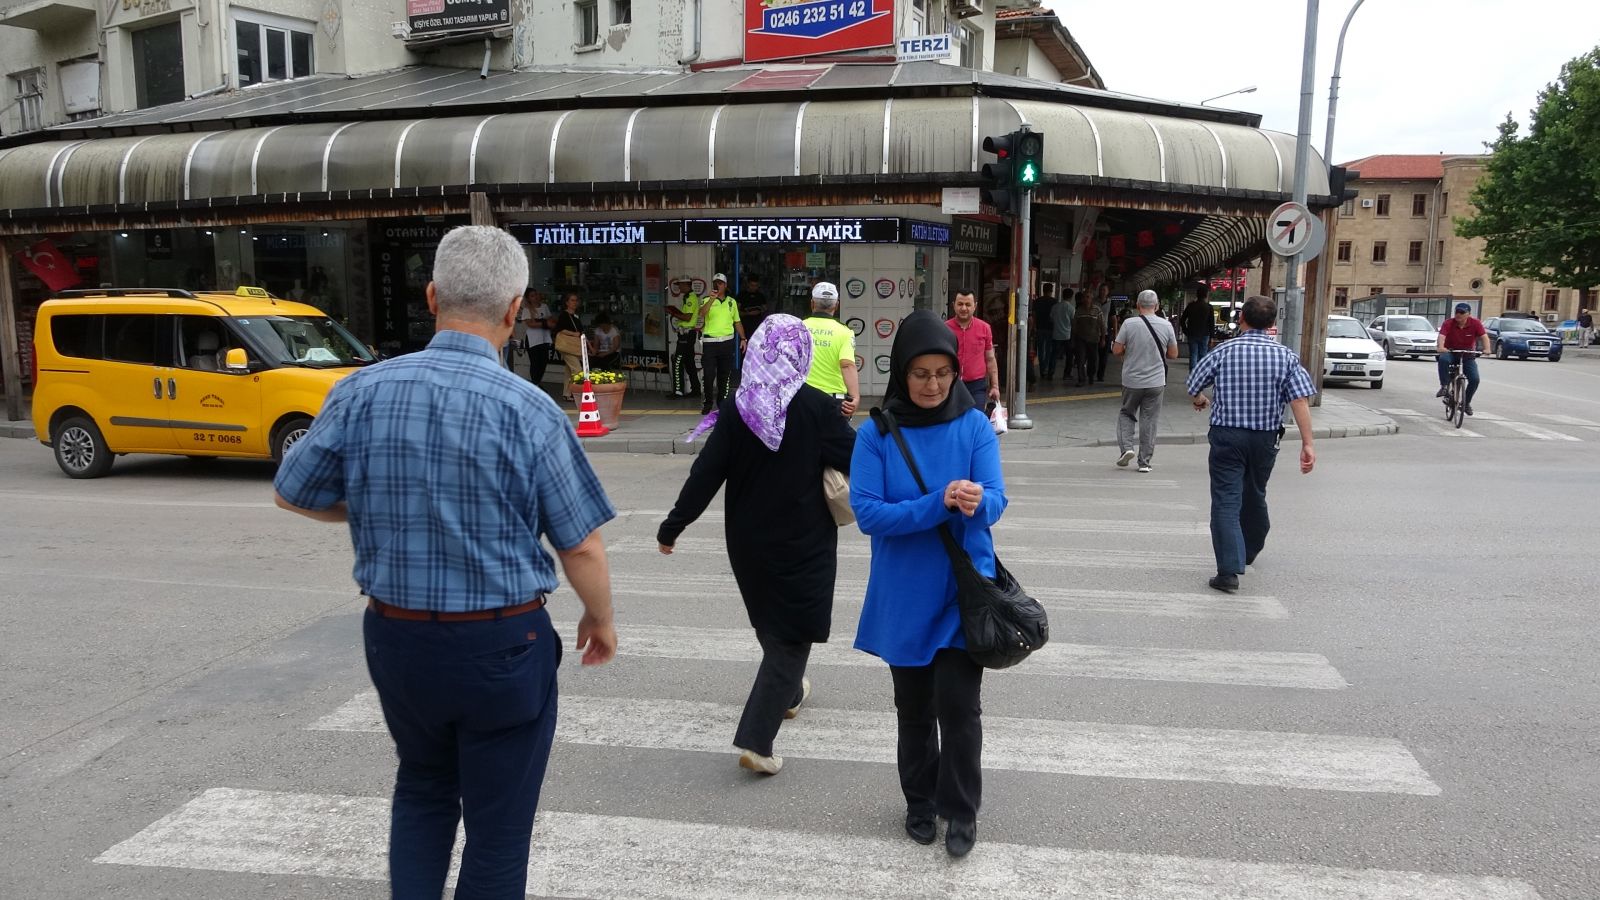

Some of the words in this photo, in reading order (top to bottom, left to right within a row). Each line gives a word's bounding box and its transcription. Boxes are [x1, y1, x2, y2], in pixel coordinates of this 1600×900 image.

[770, 10, 800, 29] 0246
[803, 7, 826, 25] 232
[829, 6, 845, 21] 51
[849, 3, 866, 18] 42
[901, 34, 949, 53] TERZİ
[535, 224, 575, 243] FATİH
[718, 225, 791, 240] TELEFON
[796, 222, 862, 240] TAMİRİ
[193, 433, 206, 441] 32
[208, 433, 216, 442] T
[218, 434, 242, 444] 0068
